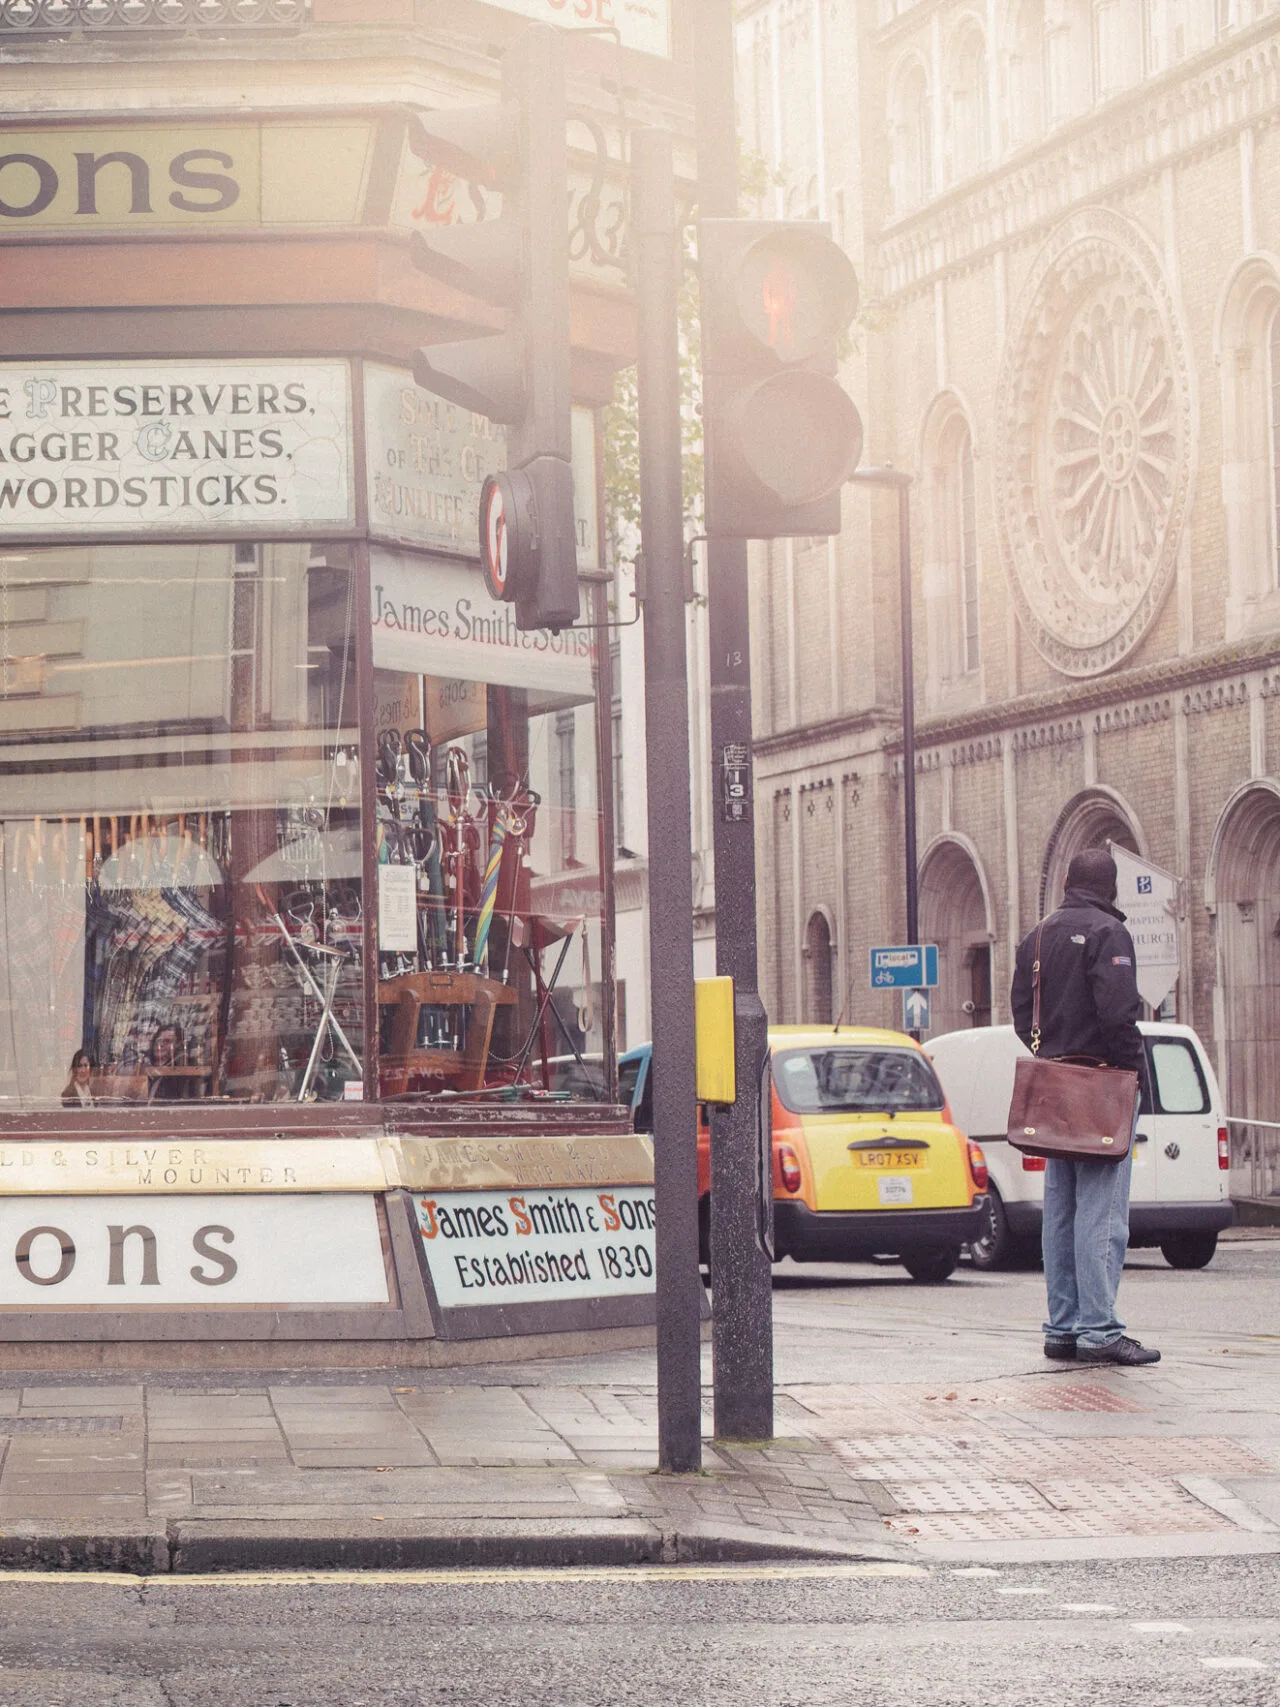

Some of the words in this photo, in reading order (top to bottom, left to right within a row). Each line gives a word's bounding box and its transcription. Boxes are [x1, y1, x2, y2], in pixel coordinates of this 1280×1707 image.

[370, 584, 450, 638] James
[454, 597, 519, 648] Smith
[1132, 932, 1175, 946] HURCH
[52, 1150, 68, 1167] &
[85, 1149, 209, 1167] SILVER
[137, 1167, 298, 1185] MOUNTER
[420, 1199, 509, 1240] James
[509, 1195, 584, 1237] Smith
[586, 1206, 600, 1233] &
[454, 1247, 591, 1289] Established
[597, 1242, 653, 1280] 1830
